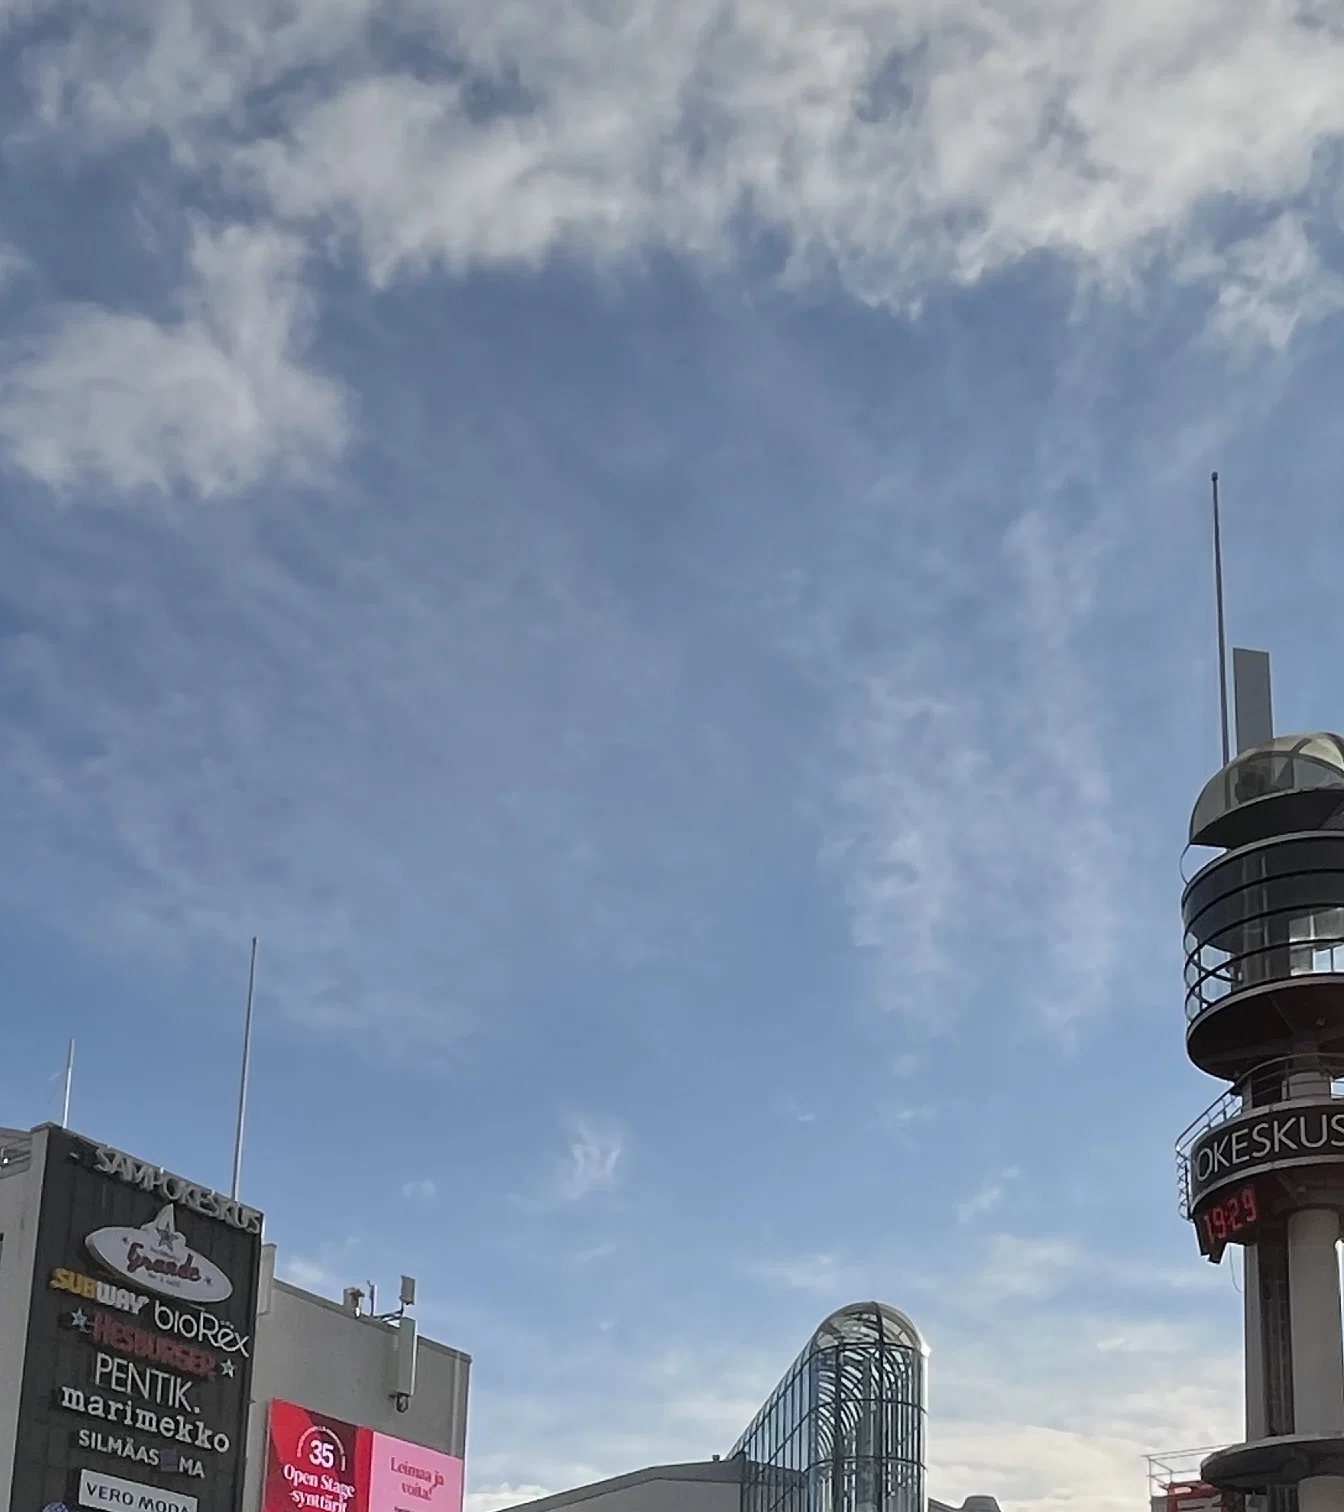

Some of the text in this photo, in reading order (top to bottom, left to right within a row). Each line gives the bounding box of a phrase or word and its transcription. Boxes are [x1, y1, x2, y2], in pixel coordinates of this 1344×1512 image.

[92, 1146, 262, 1235] SAMPOKESKUS
[1203, 1187, 1257, 1245] 19:29
[127, 1242, 202, 1282] Grande
[50, 1267, 150, 1315] SUBWAY
[61, 1386, 230, 1453] marimekko
[309, 1440, 334, 1469] 35
[390, 1456, 432, 1482] Leimaa
[86, 1482, 134, 1506] VERO
[283, 1463, 356, 1500] Open Stage
